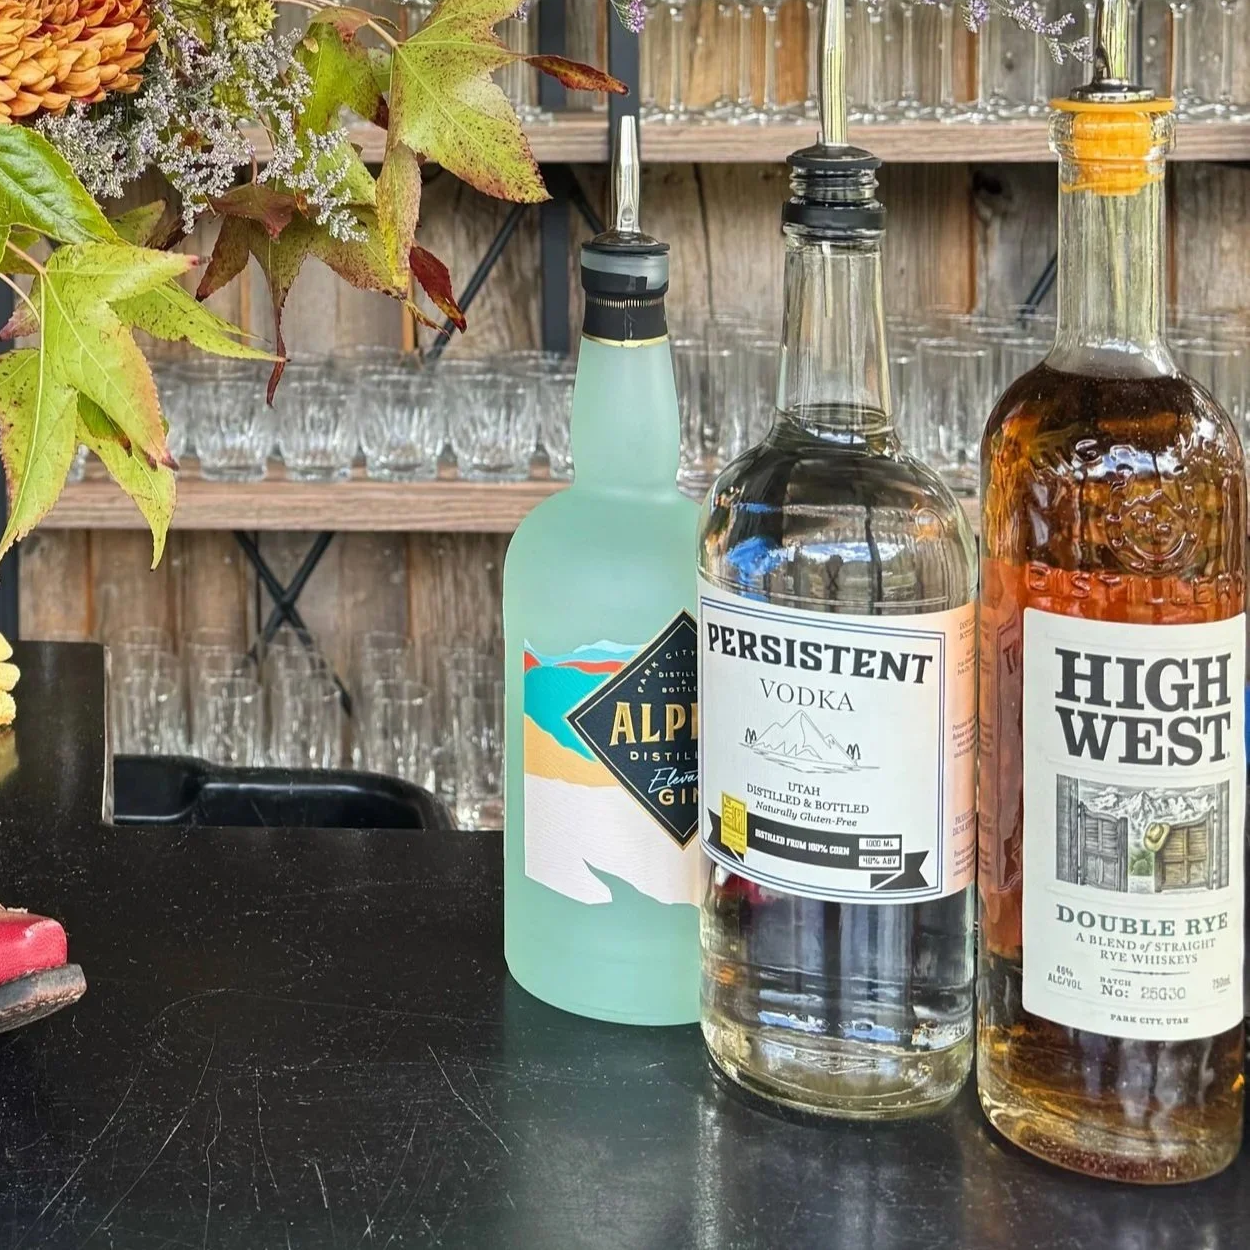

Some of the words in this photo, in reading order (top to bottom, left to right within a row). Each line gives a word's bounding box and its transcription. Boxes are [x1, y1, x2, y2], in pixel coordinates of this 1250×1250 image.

[707, 622, 933, 684] PERSISTENT
[637, 661, 659, 693] PARK
[665, 649, 695, 660] CITY
[1055, 647, 1231, 712] HIGH
[759, 678, 855, 711] VODKA
[609, 701, 698, 746] ALPI
[1055, 705, 1231, 766] WEST
[746, 783, 801, 806] DISTILLED
[803, 798, 812, 809] &
[815, 800, 870, 815] BOTTLED
[788, 782, 821, 796] UTAH
[755, 800, 798, 821] Naturally
[799, 812, 858, 827] Gluten-Free
[786, 838, 807, 851] FROM
[829, 846, 850, 857] CORN
[882, 857, 897, 865] ABV
[1056, 904, 1175, 937] DOUBLE
[1185, 912, 1228, 936] RYE
[1076, 932, 1085, 943] A
[1089, 937, 1137, 951] BLEND
[1140, 941, 1152, 953] of
[1154, 938, 1217, 952] STRAIGHT
[1100, 950, 1128, 963] RYE
[1131, 953, 1198, 965] WHISKEYS
[1047, 972, 1082, 991] ALC/VOL
[1100, 976, 1131, 987] BATCH
[1101, 984, 1129, 999] No:
[1110, 1013, 1137, 1023] PARK
[1165, 1017, 1190, 1025] UTAH
